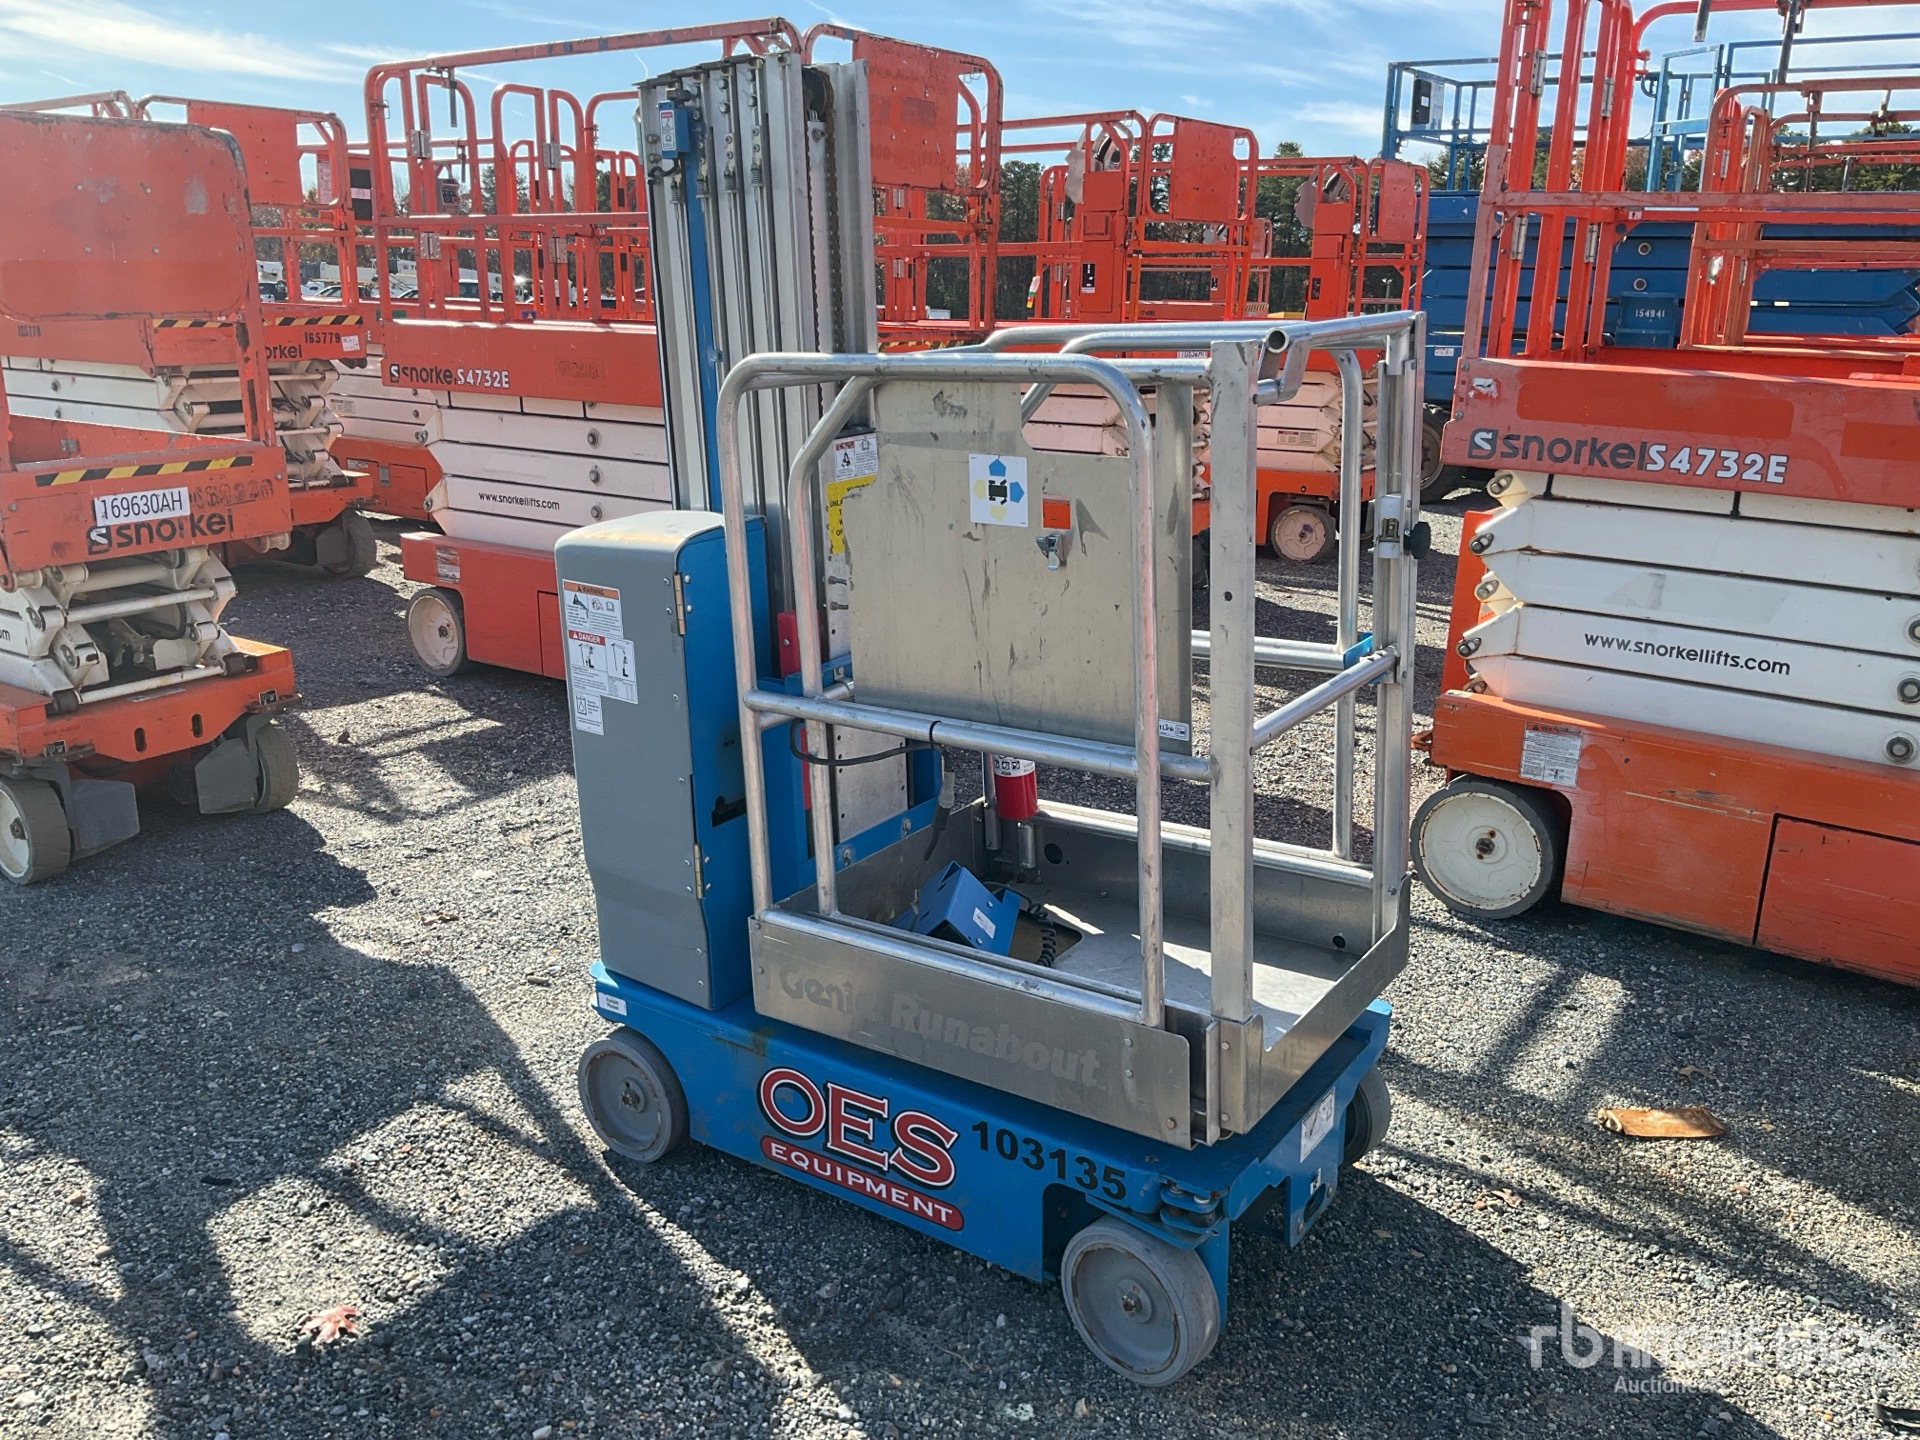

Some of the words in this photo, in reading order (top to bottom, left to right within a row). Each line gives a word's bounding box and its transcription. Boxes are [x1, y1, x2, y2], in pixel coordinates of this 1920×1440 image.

[304, 332, 341, 344] 165779
[457, 368, 510, 389] S4732E
[1500, 433, 1646, 471] snorkel
[1645, 443, 1790, 484] S4732E
[101, 491, 183, 519] 169630AH
[478, 492, 560, 511] www.snorkellifts.com
[578, 632, 601, 644] DANGER
[1584, 632, 1791, 676] www.snorkellifts.com
[891, 993, 1102, 1086] Runabout
[757, 1066, 959, 1190] OES
[972, 1120, 1127, 1200] 103135
[770, 1142, 953, 1223] EQUIPMENT
